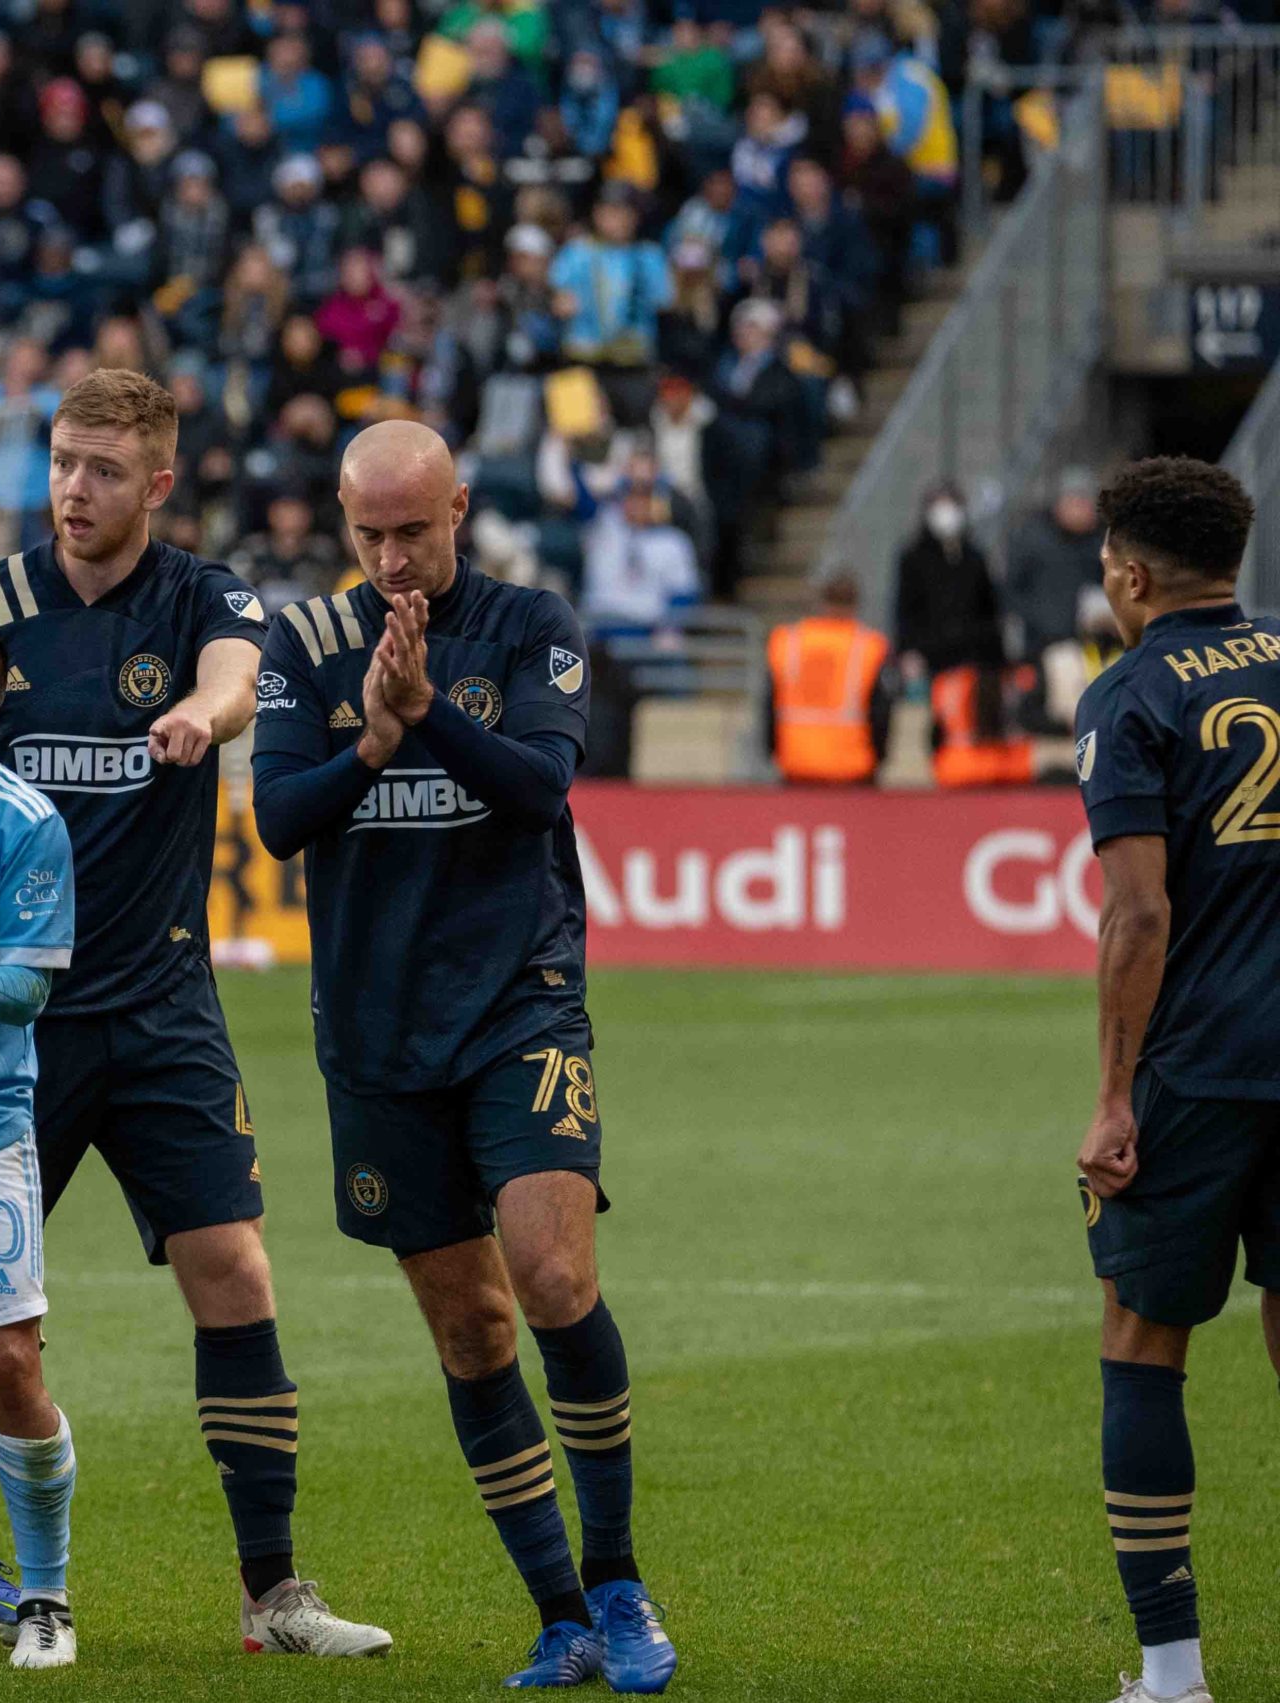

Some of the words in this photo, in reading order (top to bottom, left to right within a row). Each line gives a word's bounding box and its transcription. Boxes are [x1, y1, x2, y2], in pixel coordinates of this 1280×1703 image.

[228, 593, 249, 601] MLS
[553, 650, 573, 665] MLS
[6, 681, 32, 692] idas
[257, 698, 297, 713] BARU
[328, 717, 363, 729] adidas
[14, 745, 151, 782] BIMBO
[27, 868, 57, 886] SOL
[522, 1048, 597, 1124] 78
[551, 1127, 588, 1141] adidas
